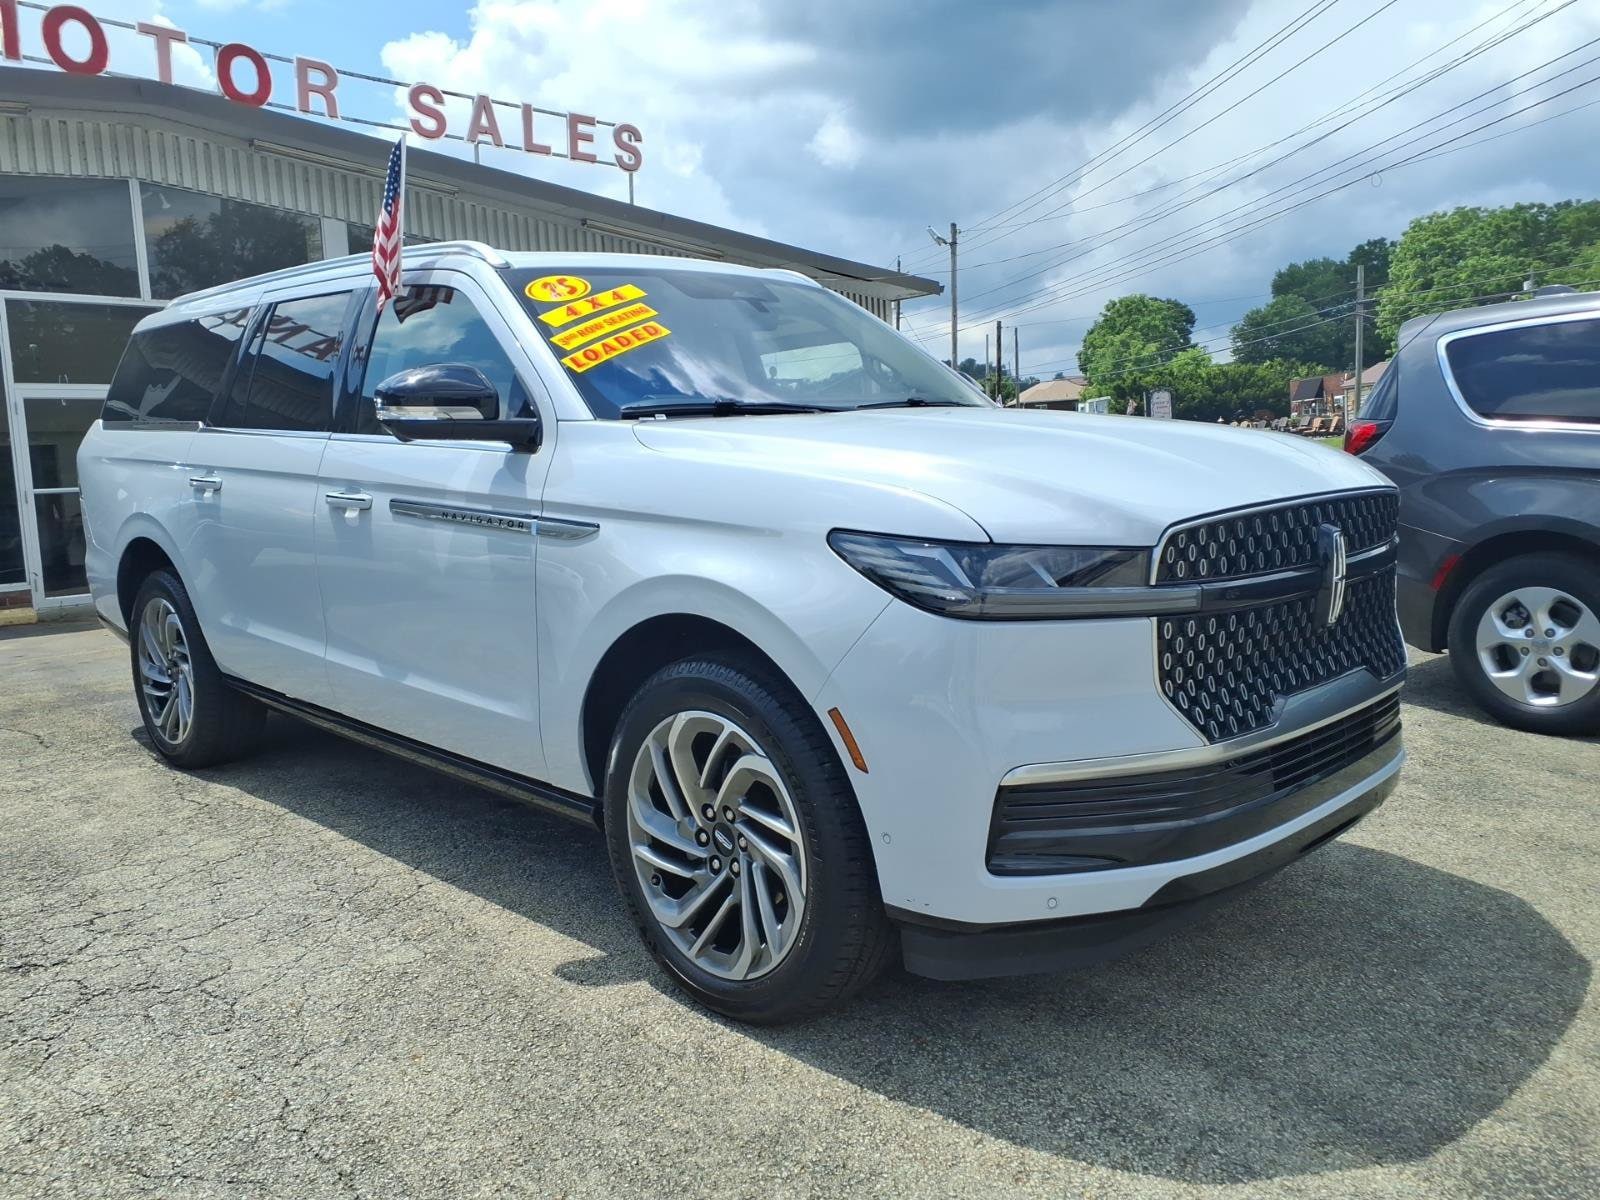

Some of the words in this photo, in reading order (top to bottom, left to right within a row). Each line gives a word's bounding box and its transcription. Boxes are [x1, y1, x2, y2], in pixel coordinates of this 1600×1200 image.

[408, 82, 643, 172] SALES
[579, 322, 604, 337] ROW
[605, 306, 650, 326] SEATING
[569, 324, 660, 368] LOADED
[442, 512, 524, 528] NAVIGATOR
